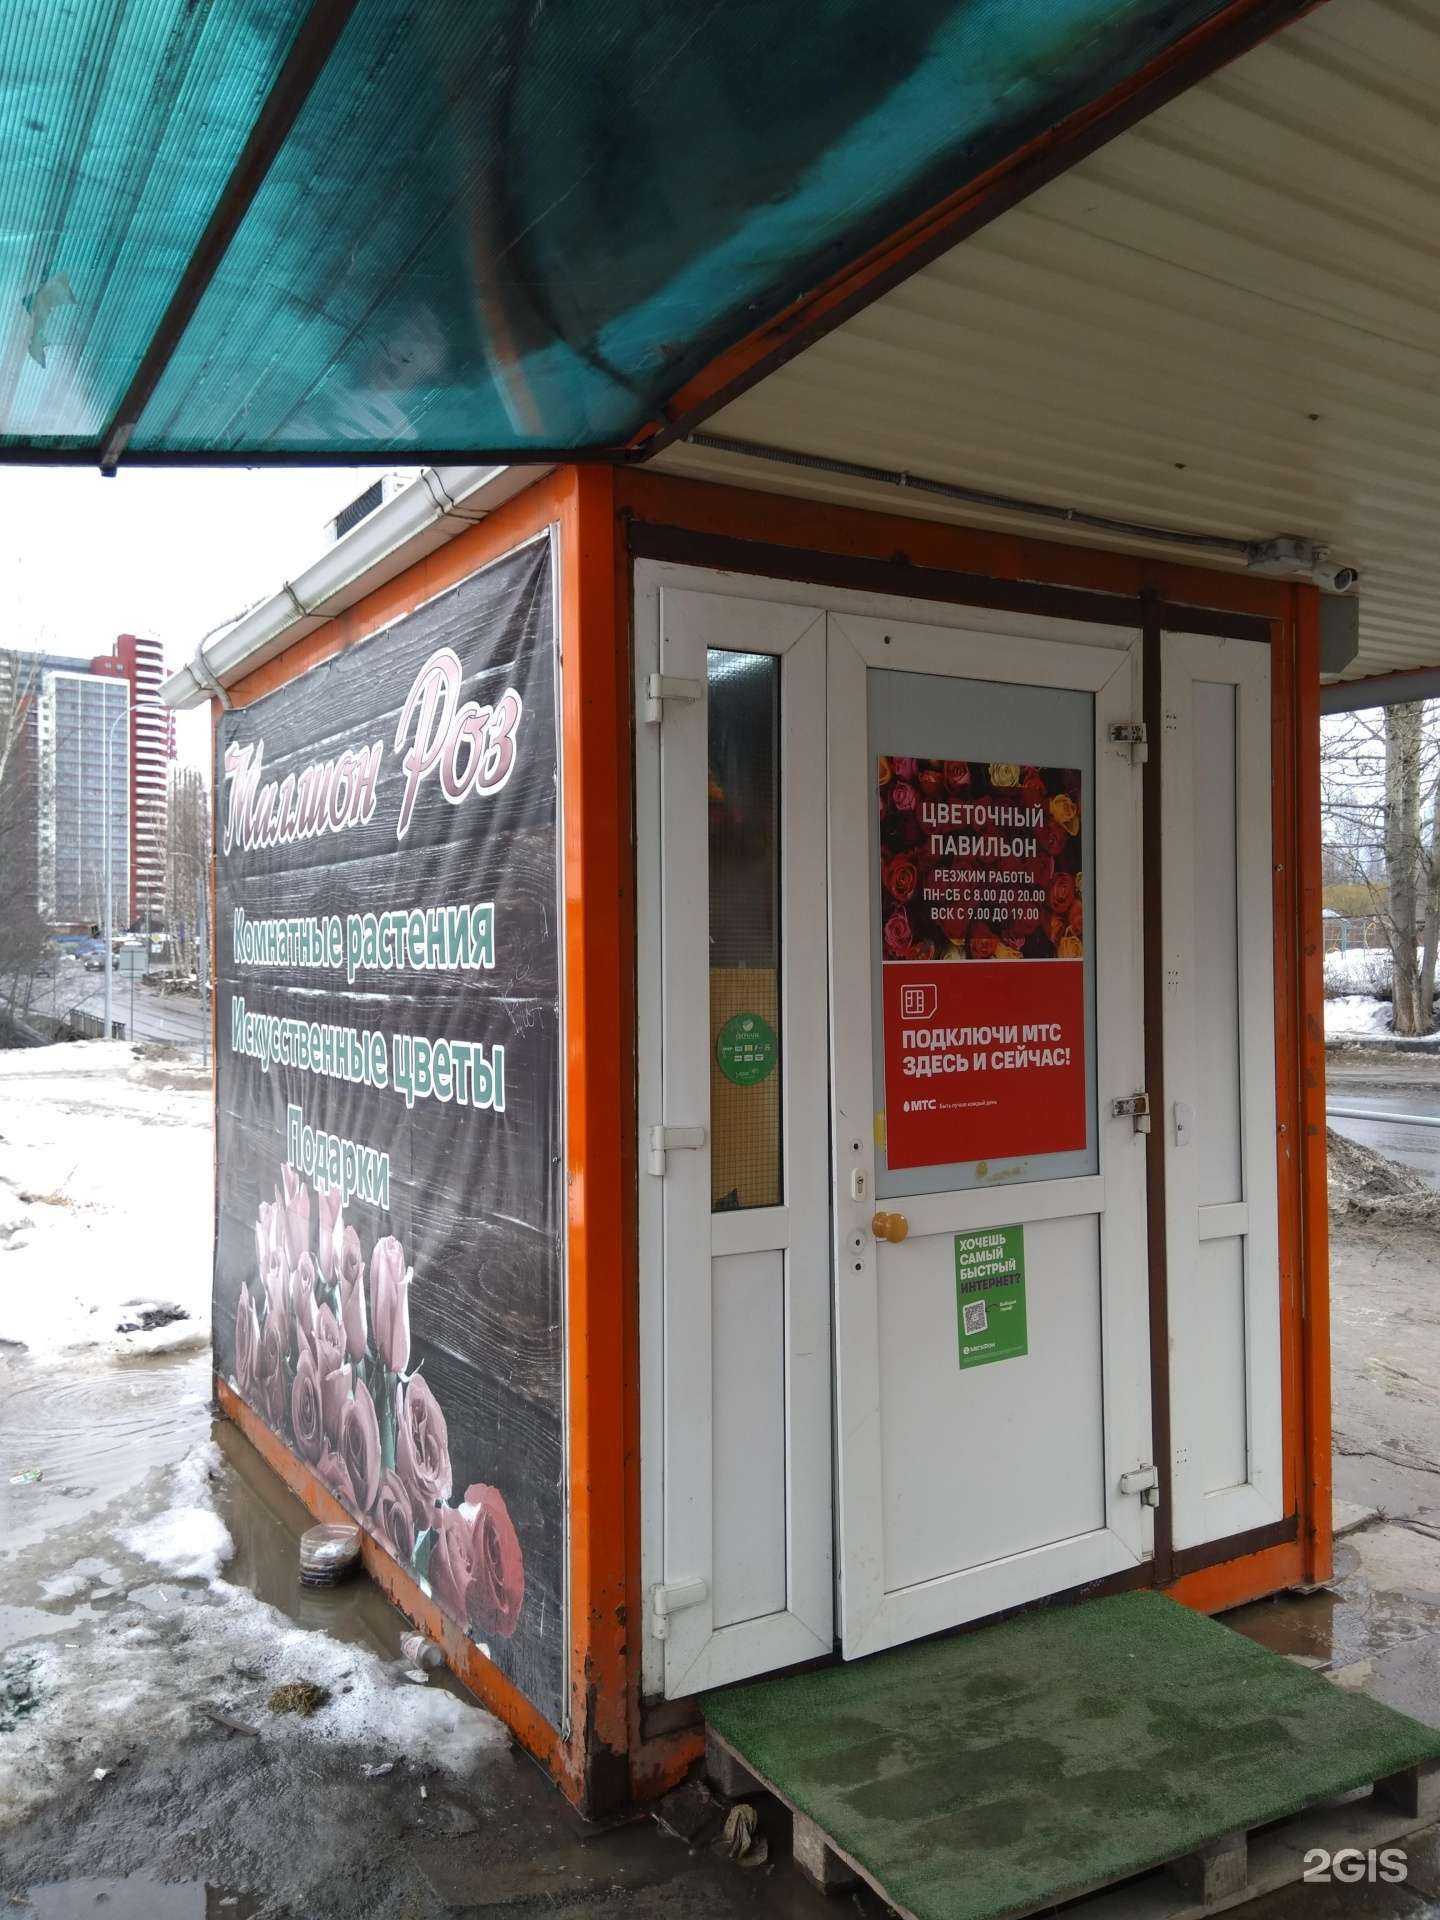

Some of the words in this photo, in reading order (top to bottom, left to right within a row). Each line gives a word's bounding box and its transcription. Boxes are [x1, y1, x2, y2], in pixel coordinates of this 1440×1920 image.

[224, 738, 384, 856] Миллион
[394, 647, 522, 840] Роз
[922, 802, 1044, 828] ЦВЕТОЧНЫЙ
[931, 834, 1037, 858] ПАВИЛЬОН
[934, 869, 986, 883] РЕЗЖИМ
[989, 871, 1034, 884] РАБОТЫ
[923, 888, 961, 901] ПН-СБ
[963, 889, 971, 902] С
[973, 889, 997, 902] 8.00
[999, 890, 1015, 904] ДО
[1017, 890, 1045, 902] 20.00
[931, 907, 954, 920] ВСК
[956, 908, 965, 920] С
[967, 908, 990, 921] 9.00
[992, 908, 1009, 922] ДО
[1012, 908, 1039, 921] 19.00
[234, 907, 343, 968] Комнатные
[346, 902, 496, 984] растения
[902, 1026, 1018, 1051] ПОДКЛЮЧИ
[1022, 1023, 1062, 1043] МТС
[232, 995, 389, 1089] Искусственные
[392, 1033, 506, 1112] цветы
[902, 1053, 969, 1078] ЗДЕСЬ
[973, 1053, 987, 1071] И
[991, 1045, 1071, 1070] СЕЙЧАС!
[911, 1099, 937, 1111] МТС
[286, 1103, 391, 1211] Подарки
[960, 1234, 1006, 1251] ХОЧЕШЬ
[960, 1246, 1004, 1265] САМЫЙ
[960, 1258, 1017, 1280] БЫСТРЫЙ
[960, 1273, 1021, 1294] ИНТЕРНЕТ?
